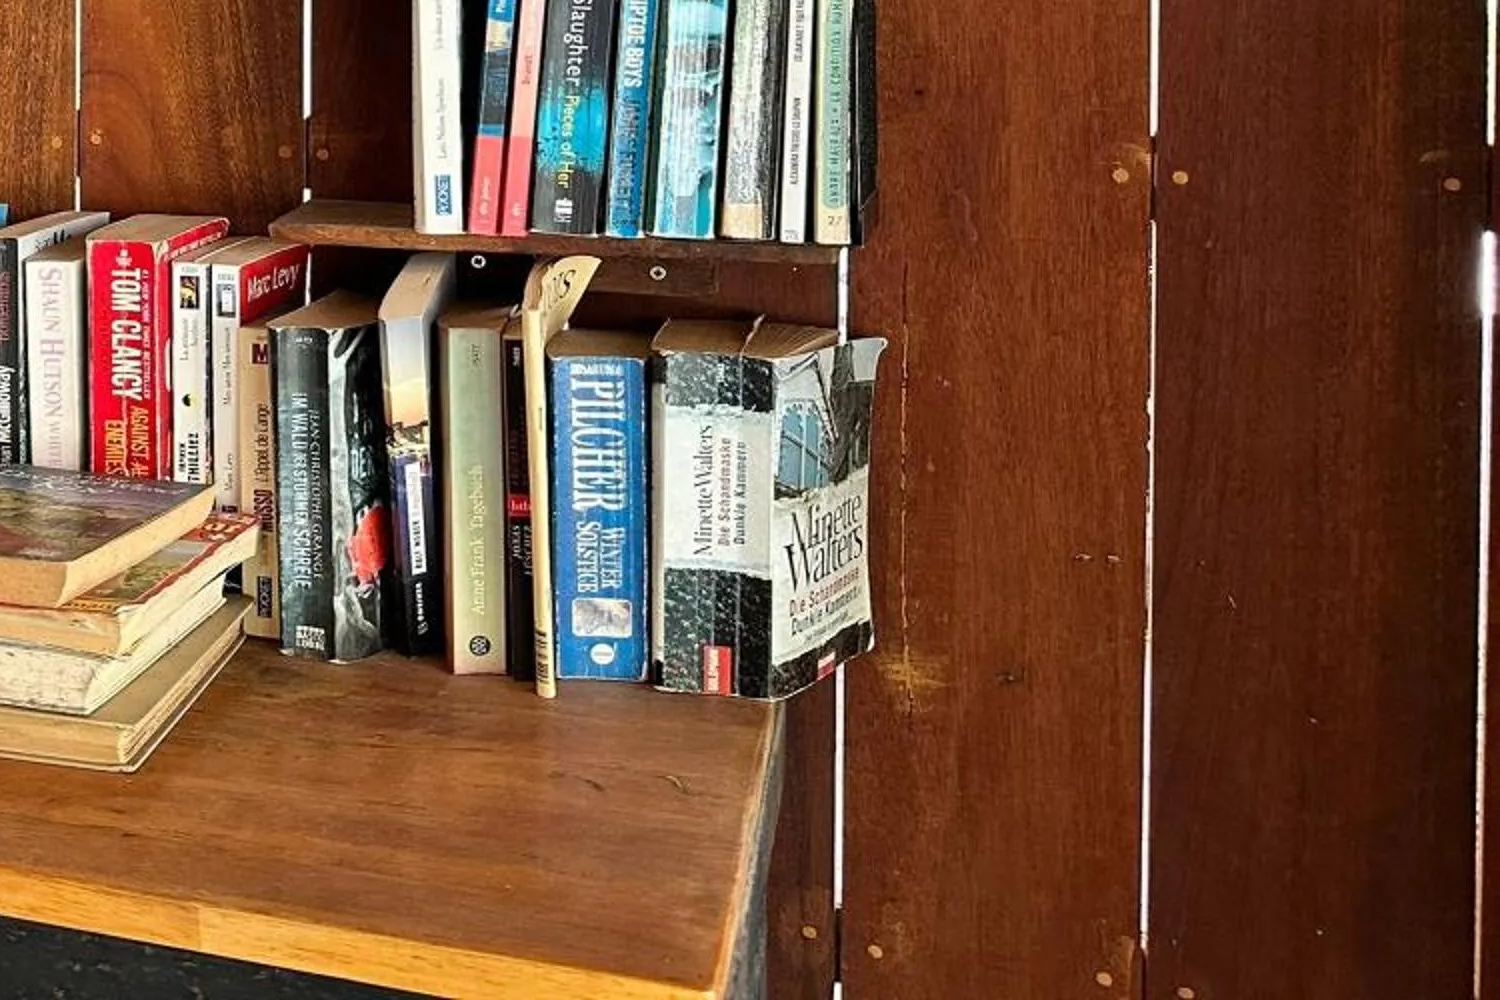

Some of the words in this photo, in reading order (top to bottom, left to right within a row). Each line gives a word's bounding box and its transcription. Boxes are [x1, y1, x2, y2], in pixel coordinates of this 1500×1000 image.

[622, 46, 643, 89] BOYS
[562, 94, 582, 138] Pieces
[561, 138, 576, 158] of
[556, 160, 574, 189] Her
[39, 266, 66, 334] SHAUN
[110, 267, 142, 313] TOM
[246, 268, 273, 304] Marc
[270, 261, 300, 294] Levy
[38, 337, 66, 418] HUTSON
[110, 318, 143, 401] CLANCY
[292, 392, 308, 409] IM
[42, 420, 64, 468] WHITE
[103, 418, 127, 478] ENEMIES
[127, 405, 150, 459] AGAINST
[255, 433, 269, 449] de
[293, 412, 309, 450] WALD
[571, 380, 628, 512] PILCHER
[693, 424, 714, 487] Walters
[186, 432, 200, 482] THILLIEZ
[254, 449, 270, 484] L'Appel
[308, 409, 323, 522] JEAN-CHRISTOPHE
[717, 437, 732, 523] Schandmaske
[733, 441, 747, 500] Kammern
[254, 488, 275, 534] MUSSO
[295, 468, 311, 527] STUMMEN
[470, 464, 488, 531] Tagebuch
[692, 486, 715, 558] Minette
[718, 525, 732, 547] Die
[732, 502, 747, 545] Dunkle
[792, 492, 863, 558] Minette
[296, 528, 313, 590] SCHREIE
[470, 535, 487, 577] Frank
[578, 520, 600, 594] SOLSTICE
[600, 526, 619, 590] WINTER
[784, 524, 865, 595] Walters
[470, 577, 487, 615] Anne
[788, 596, 807, 619] Die
[790, 608, 823, 637] Dunkle
